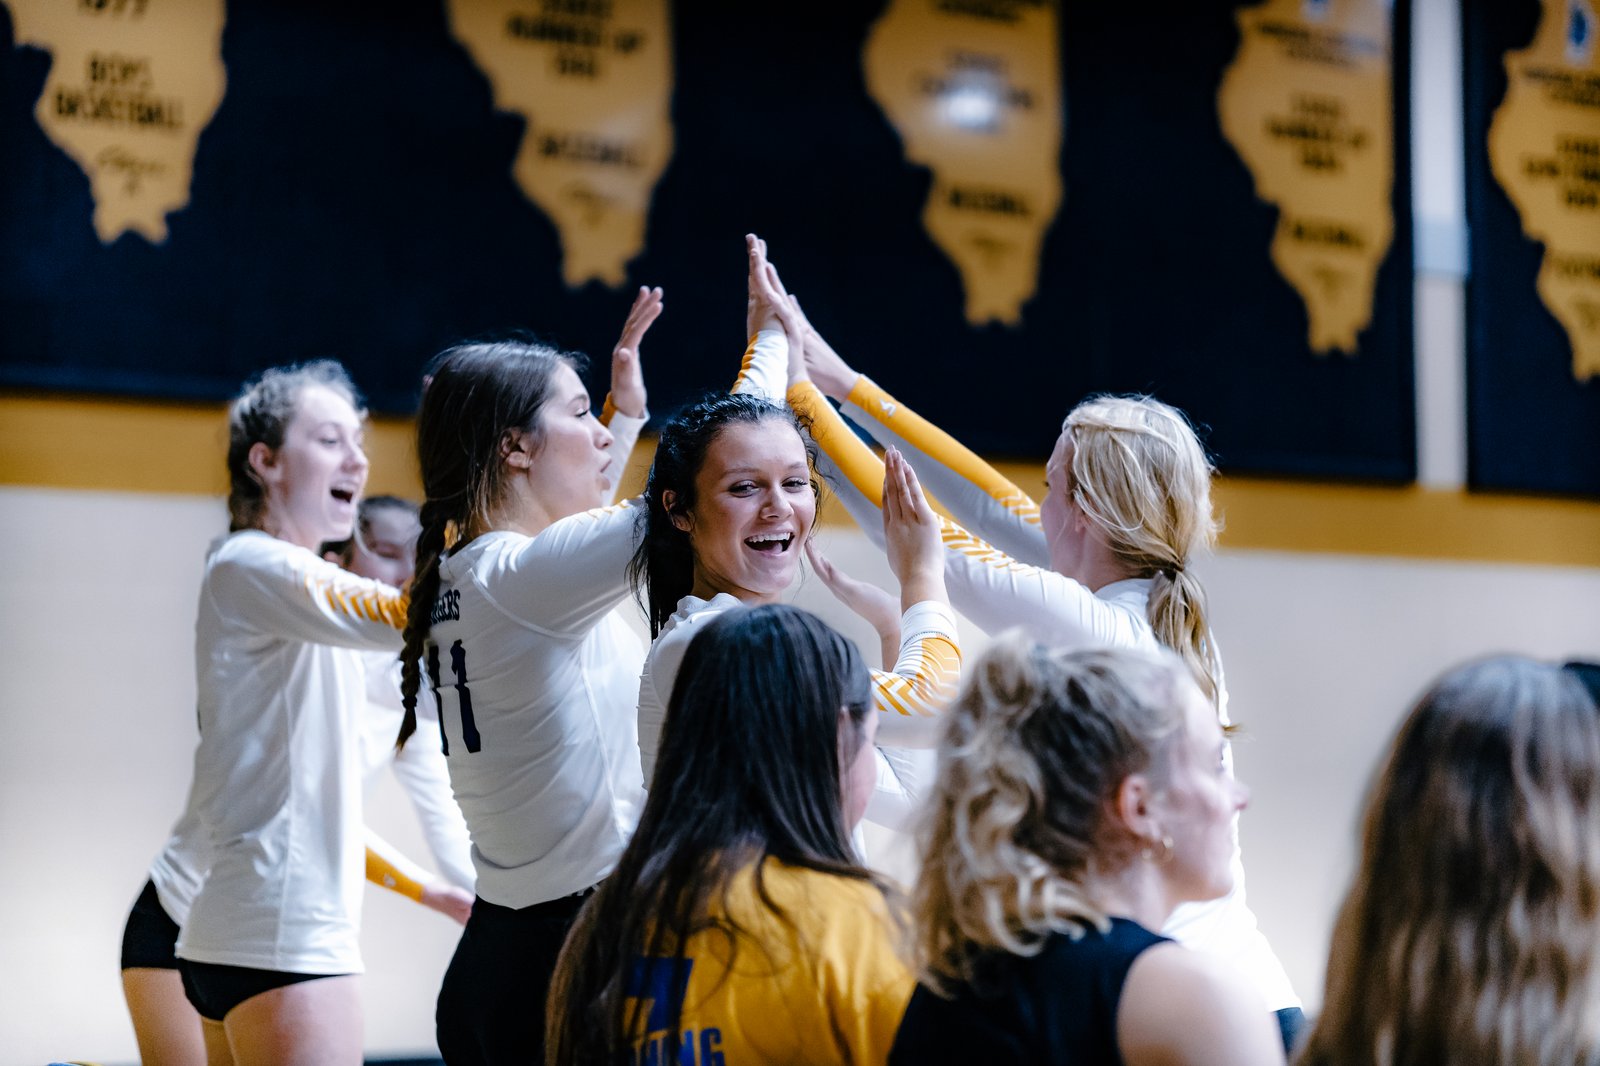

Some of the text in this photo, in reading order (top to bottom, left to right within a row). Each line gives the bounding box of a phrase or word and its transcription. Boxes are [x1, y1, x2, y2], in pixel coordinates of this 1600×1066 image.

[87, 54, 152, 91] BOYS
[53, 85, 185, 132] BASKETBALL
[427, 638, 482, 756] 11
